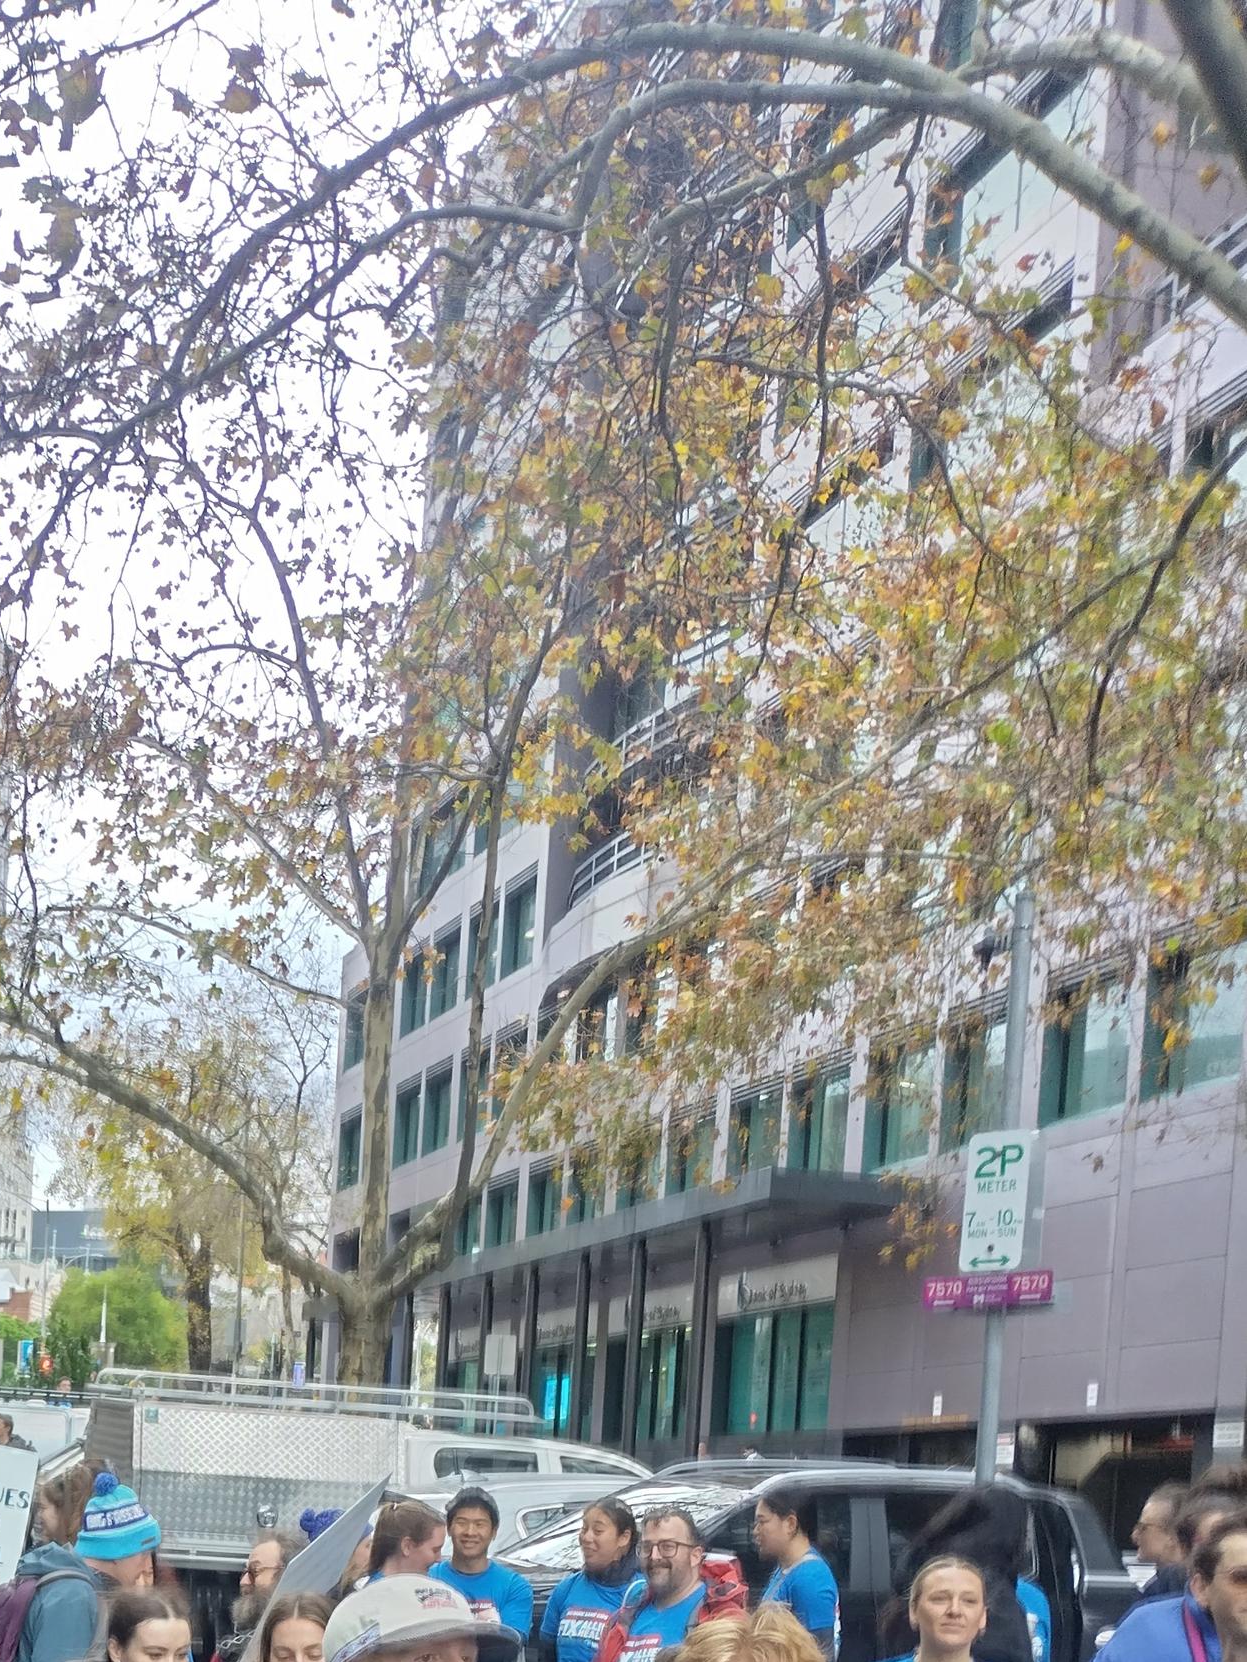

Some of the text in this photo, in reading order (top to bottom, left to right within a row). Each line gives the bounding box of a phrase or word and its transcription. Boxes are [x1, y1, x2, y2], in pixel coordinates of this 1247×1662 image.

[975, 1144, 1024, 1178] 2P
[977, 1179, 1017, 1194] METER
[967, 1228, 987, 1239] MON
[997, 1226, 1017, 1238] SUN
[927, 1281, 963, 1297] 7570
[1012, 1274, 1049, 1292] 7570
